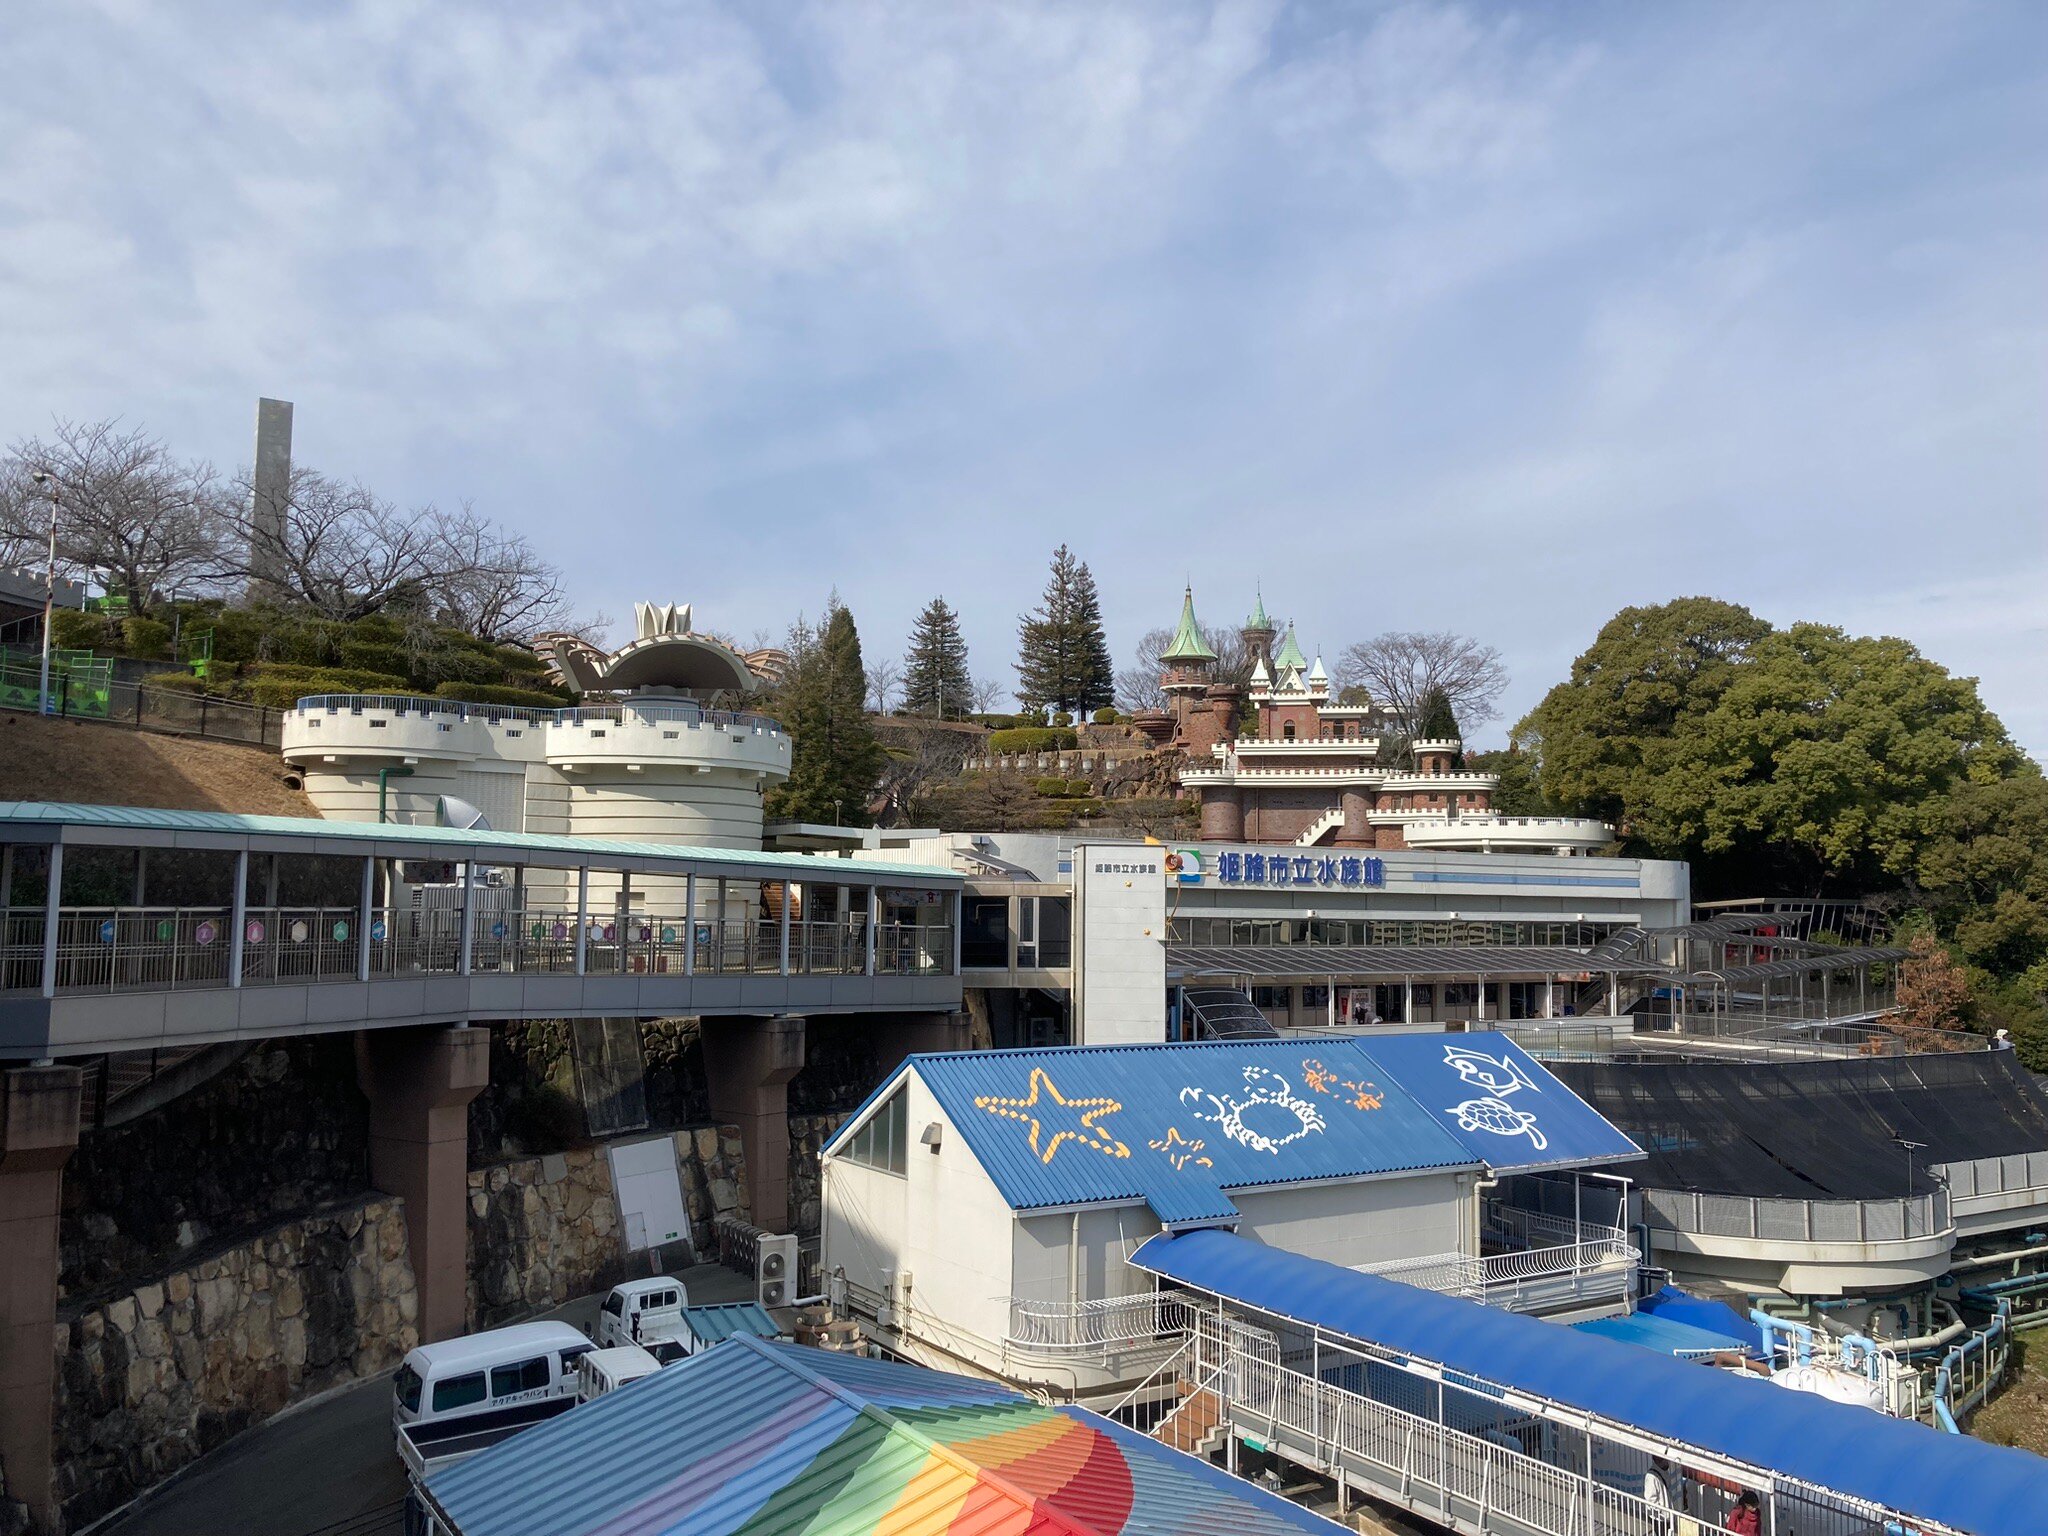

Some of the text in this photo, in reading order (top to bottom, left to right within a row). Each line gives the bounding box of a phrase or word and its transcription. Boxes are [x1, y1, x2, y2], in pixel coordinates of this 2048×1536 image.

[1095, 863, 1157, 874] 姫路市立水族館
[1217, 851, 1383, 885] 姫路市立水族館
